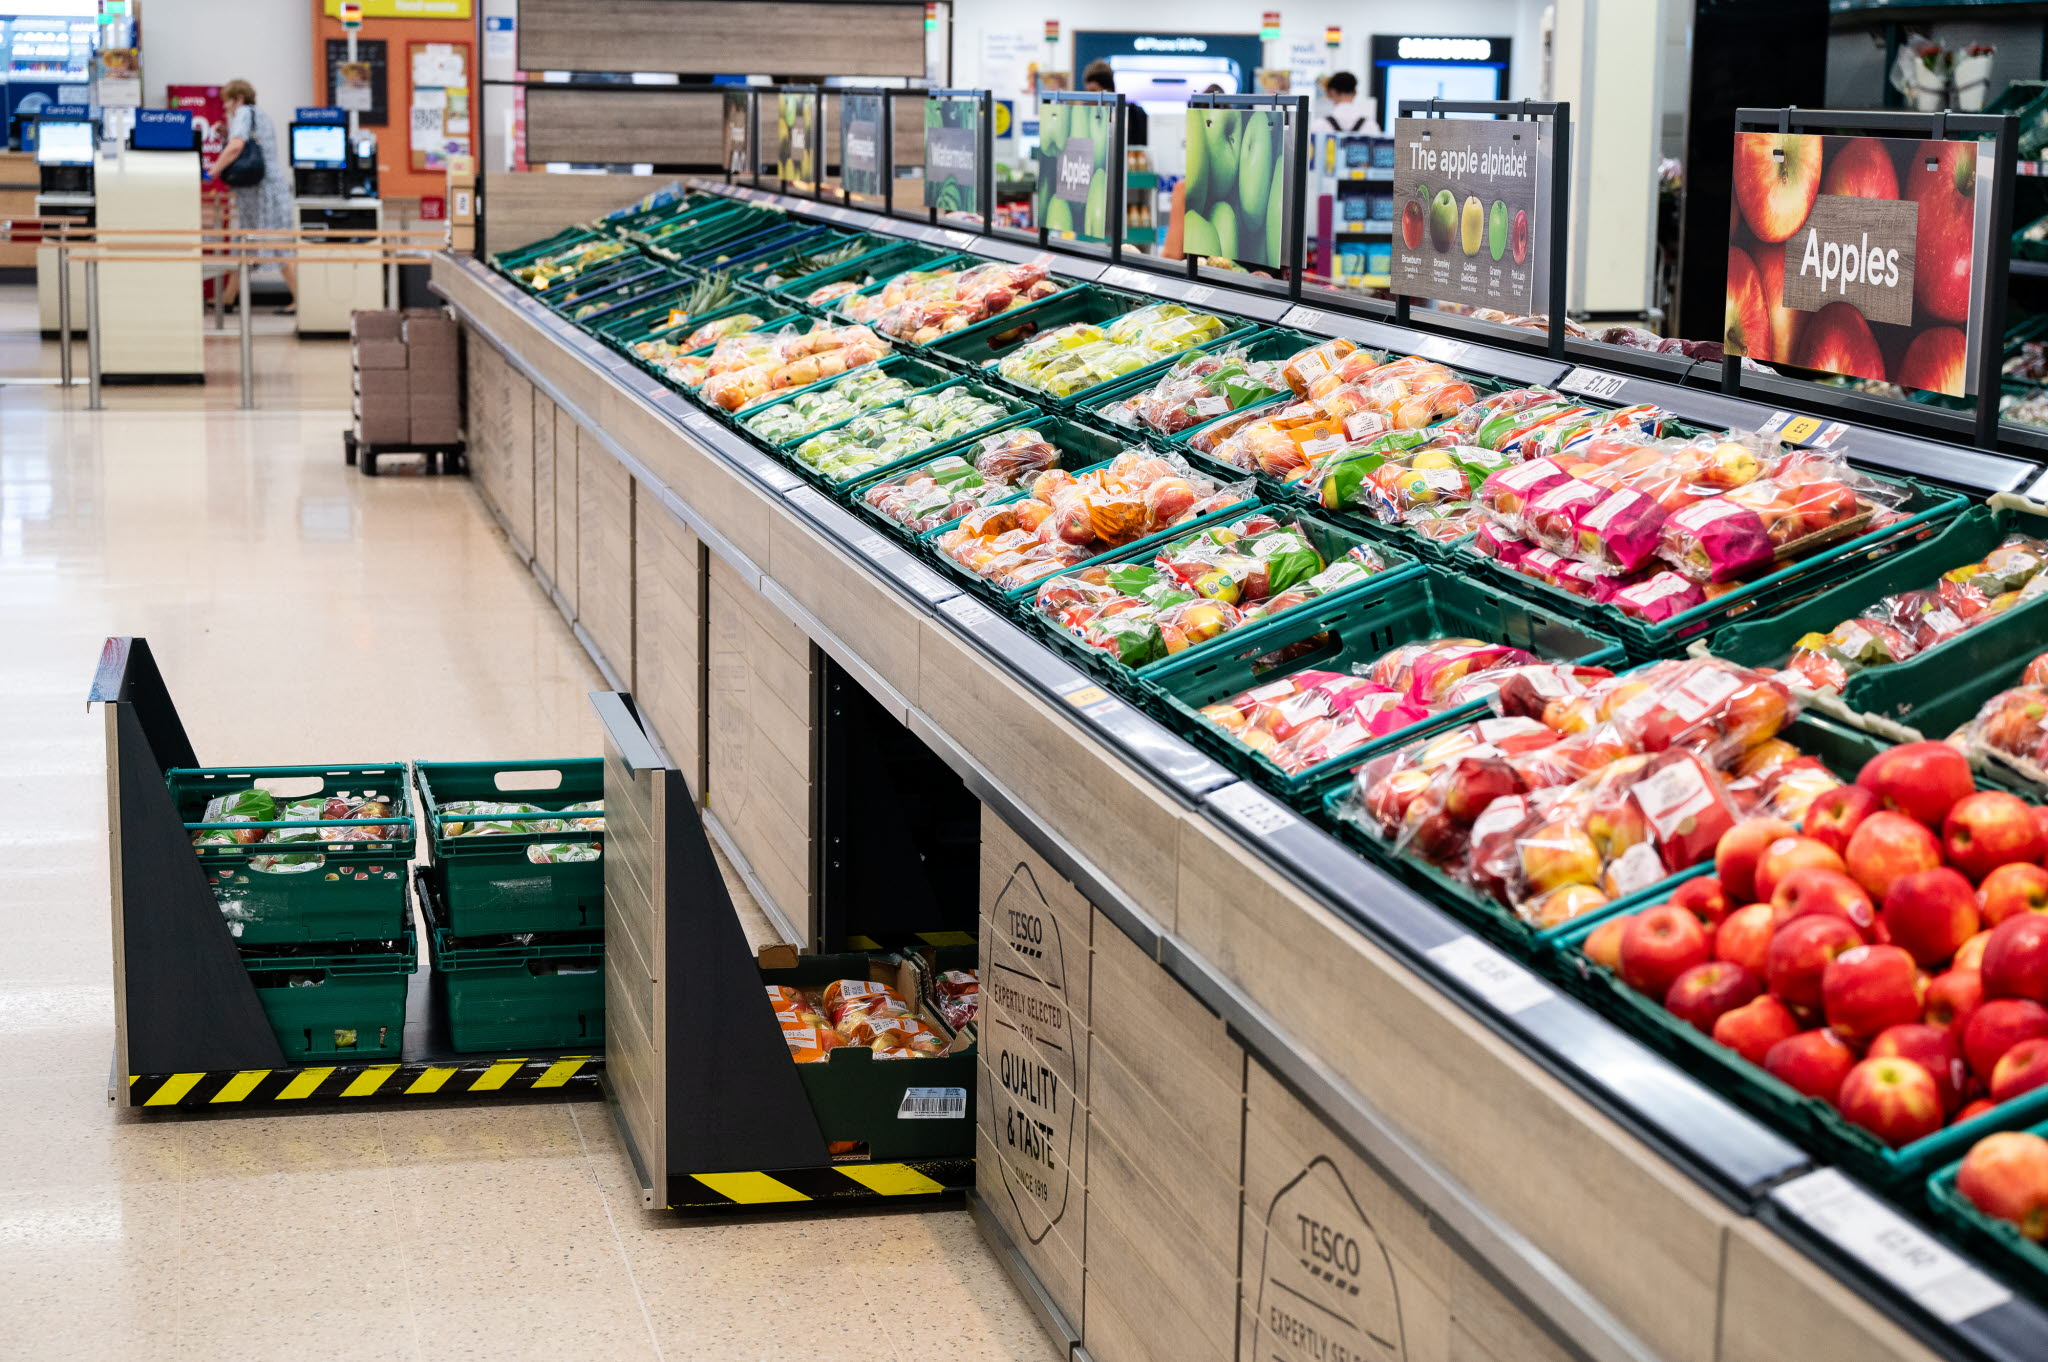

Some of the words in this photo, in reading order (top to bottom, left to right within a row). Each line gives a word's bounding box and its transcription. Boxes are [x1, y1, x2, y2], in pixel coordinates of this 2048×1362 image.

[141, 112, 163, 123] Card
[165, 113, 186, 124] Only
[1061, 155, 1091, 190] Apples
[1409, 142, 1437, 171] The
[1440, 144, 1478, 180] apple
[1481, 145, 1527, 183] alphabet
[1401, 254, 1422, 265] Braeburn
[1433, 258, 1451, 270] Bramley
[1463, 262, 1477, 273] Golden
[1800, 228, 1900, 295] Apples
[1583, 375, 1622, 395] £1.70
[1008, 909, 1042, 945] TESCO
[994, 983, 1026, 1015] EXPERTLY
[1027, 996, 1062, 1029] SELECTED
[1021, 1023, 1034, 1045] FOR
[1000, 1048, 1057, 1114] QUALITY
[1007, 1105, 1016, 1148] &
[1016, 1110, 1055, 1171] TASTE
[1015, 1166, 1034, 1194] SINCE
[1034, 1177, 1048, 1202] 1919
[1297, 1213, 1361, 1277] TESCO
[1270, 1305, 1328, 1362] EXPERTLY
